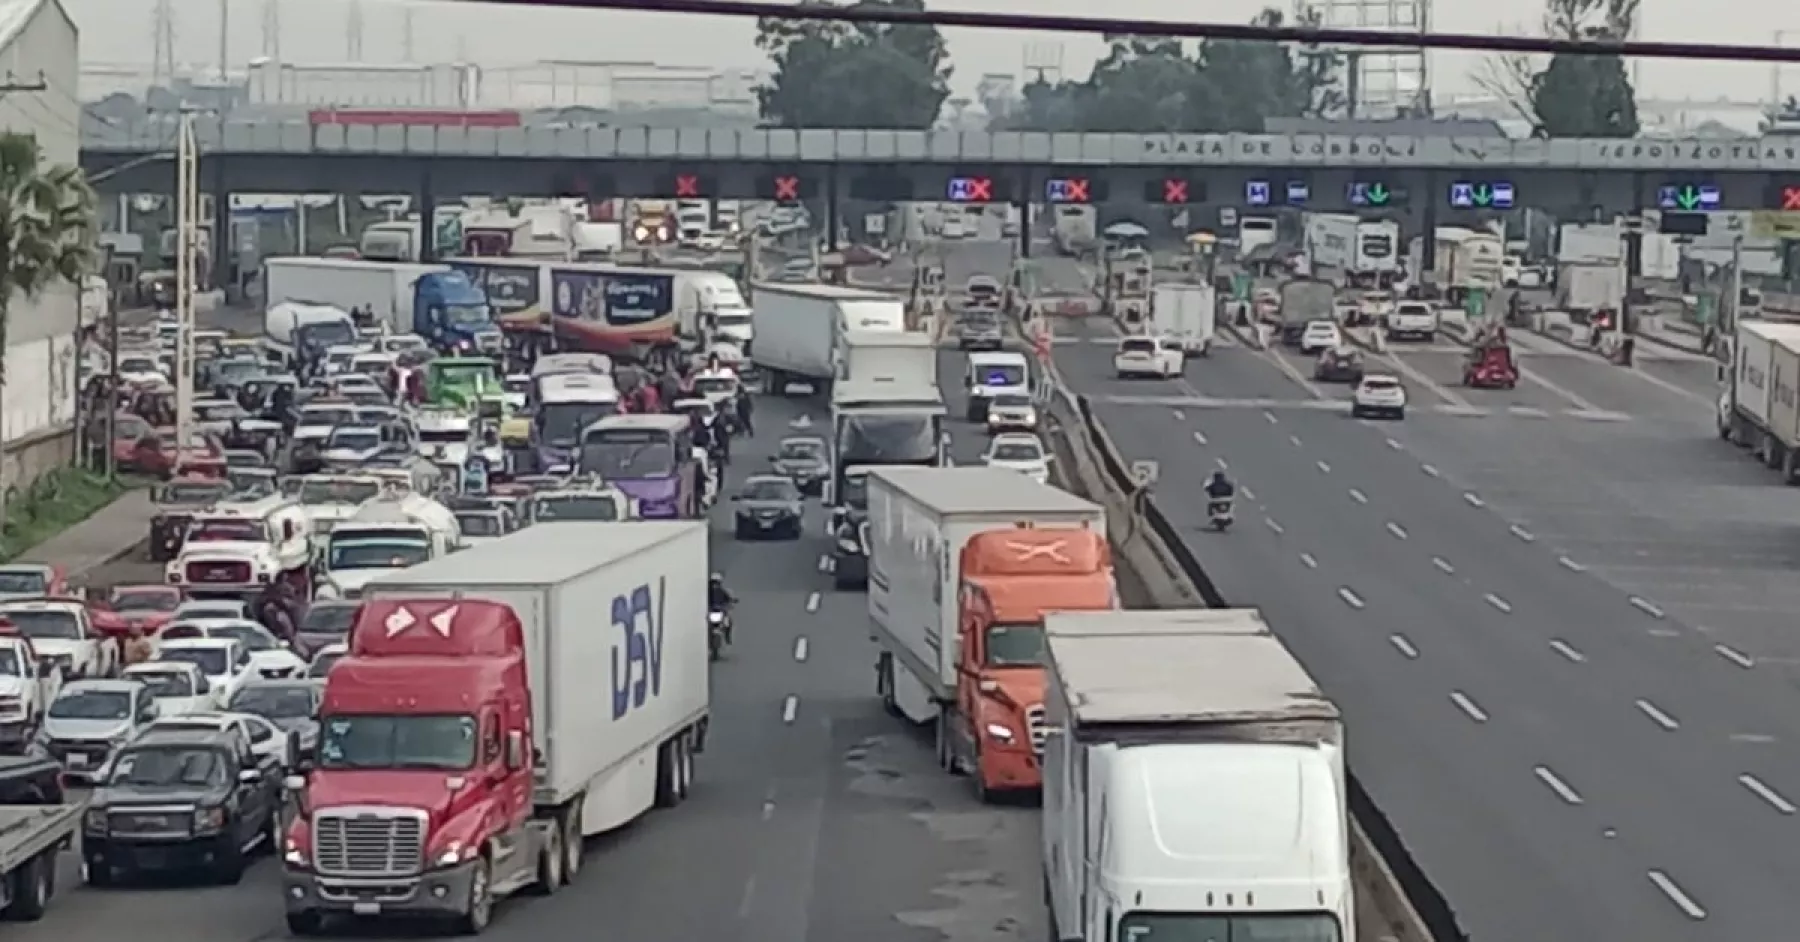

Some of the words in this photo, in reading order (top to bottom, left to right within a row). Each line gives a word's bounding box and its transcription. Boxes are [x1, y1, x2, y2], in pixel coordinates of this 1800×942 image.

[1145, 140, 1223, 156] PLAZA
[1242, 140, 1272, 155] DE
[611, 575, 666, 722] DSV
